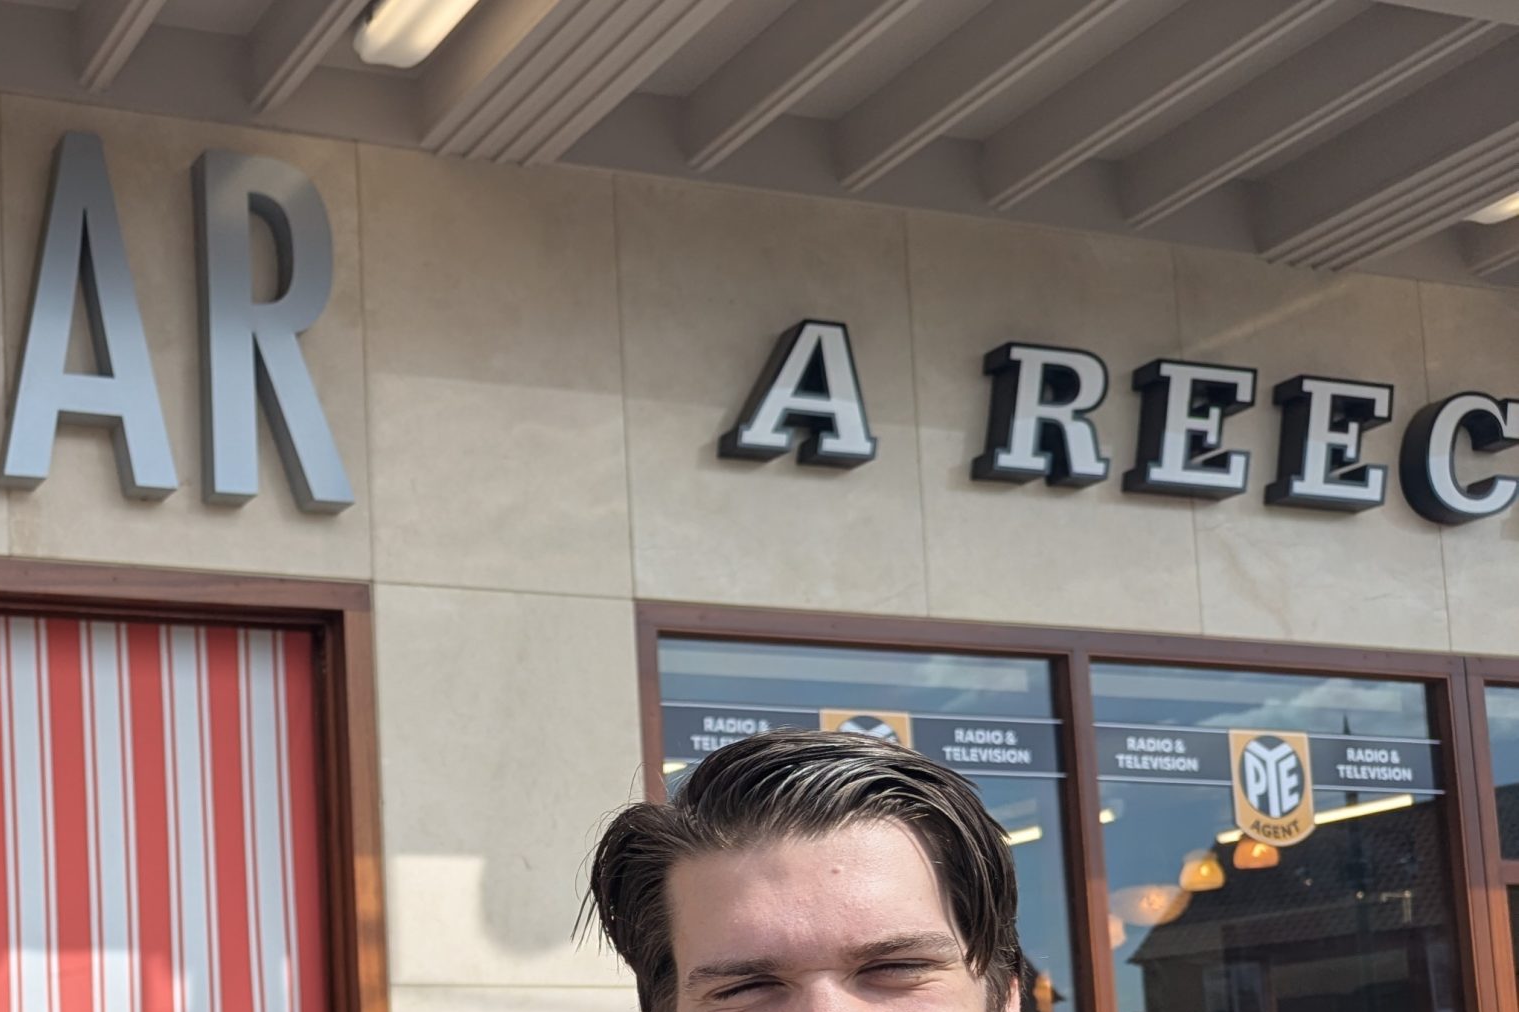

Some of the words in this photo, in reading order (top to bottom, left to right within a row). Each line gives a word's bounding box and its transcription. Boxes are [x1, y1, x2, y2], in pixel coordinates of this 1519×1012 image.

[718, 318, 877, 467] A
[703, 717, 756, 734] RADIO
[954, 728, 1002, 745] RADIO
[1005, 730, 1017, 745] &
[1127, 737, 1172, 753] RADIO
[1174, 739, 1185, 753] &
[942, 747, 1031, 764] TELEVISION
[1115, 755, 1199, 772] TELEVISION
[1346, 748, 1390, 764] RADIO
[1390, 751, 1400, 765] &
[1243, 740, 1300, 818] PYE
[1337, 765, 1413, 781] TELEVISION
[1250, 820, 1301, 840] AGENT
